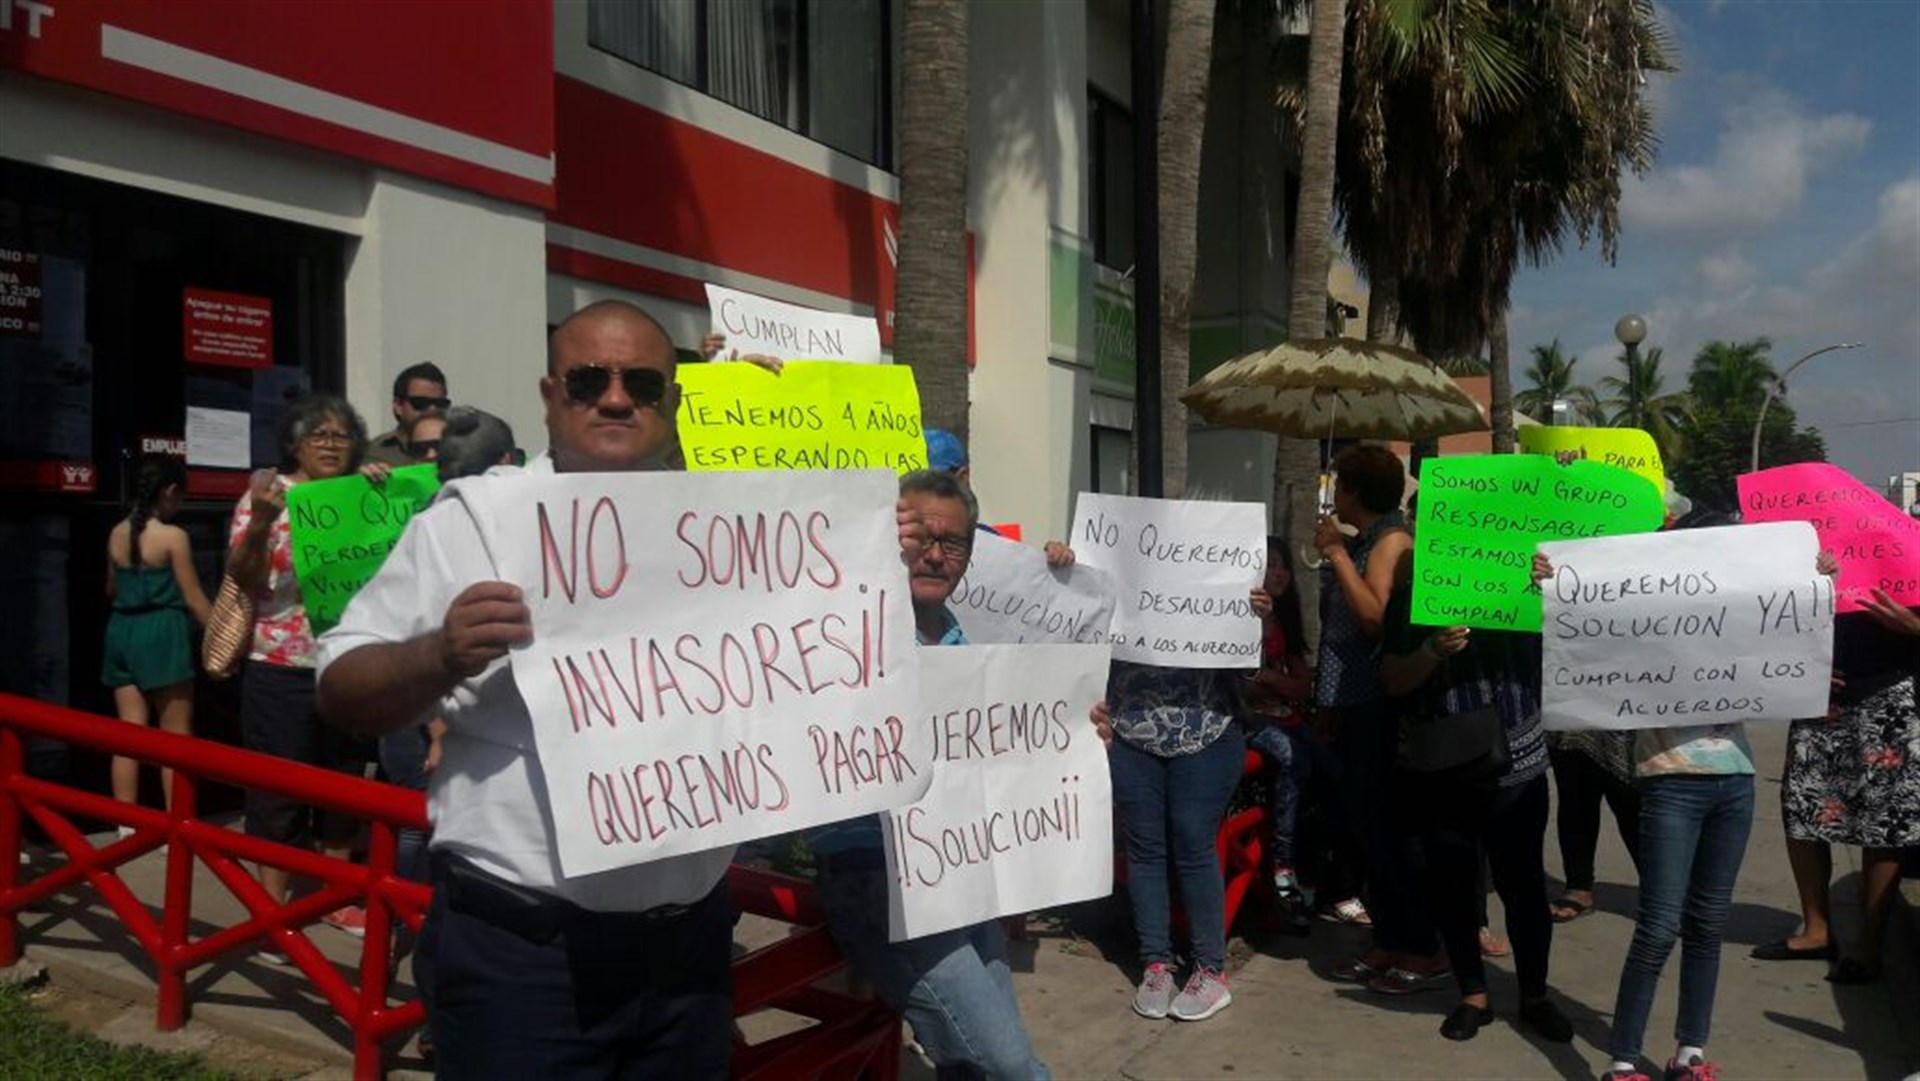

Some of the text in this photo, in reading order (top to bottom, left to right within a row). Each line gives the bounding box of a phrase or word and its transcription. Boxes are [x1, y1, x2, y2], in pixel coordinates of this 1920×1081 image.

[10, 285, 41, 298] 2:30
[720, 299, 845, 356] CUMPLAN
[680, 391, 921, 438] TENEMOS 4 AÑOS
[694, 441, 922, 473] ESPERANDO LAS
[1604, 451, 1646, 470] PARA
[1431, 466, 1627, 509] SOMOS UN GRUPO
[296, 499, 340, 529] NO
[1430, 501, 1607, 537] RESPONSABLE
[537, 496, 841, 603] NO SOMOS
[1086, 513, 1263, 570] NO QUEREMOS
[1428, 538, 1527, 568] ESTAMOS
[1827, 543, 1905, 559] ALES
[1422, 568, 1461, 587] CON
[1473, 580, 1508, 594] LOS
[1556, 564, 1717, 605] QUEREMOS
[1138, 591, 1258, 618] DESALOJAD
[1425, 596, 1519, 625] CUMPLAN
[1555, 606, 1727, 639] SOLUCION
[1134, 636, 1145, 648] A
[1153, 638, 1177, 653] LOS
[1555, 661, 1807, 687] CUMPLAN CON LOS
[1616, 697, 1764, 717] ACUERDOS
[931, 700, 1070, 762] EREMOS
[588, 716, 917, 845] QUEREMOS PAGAR
